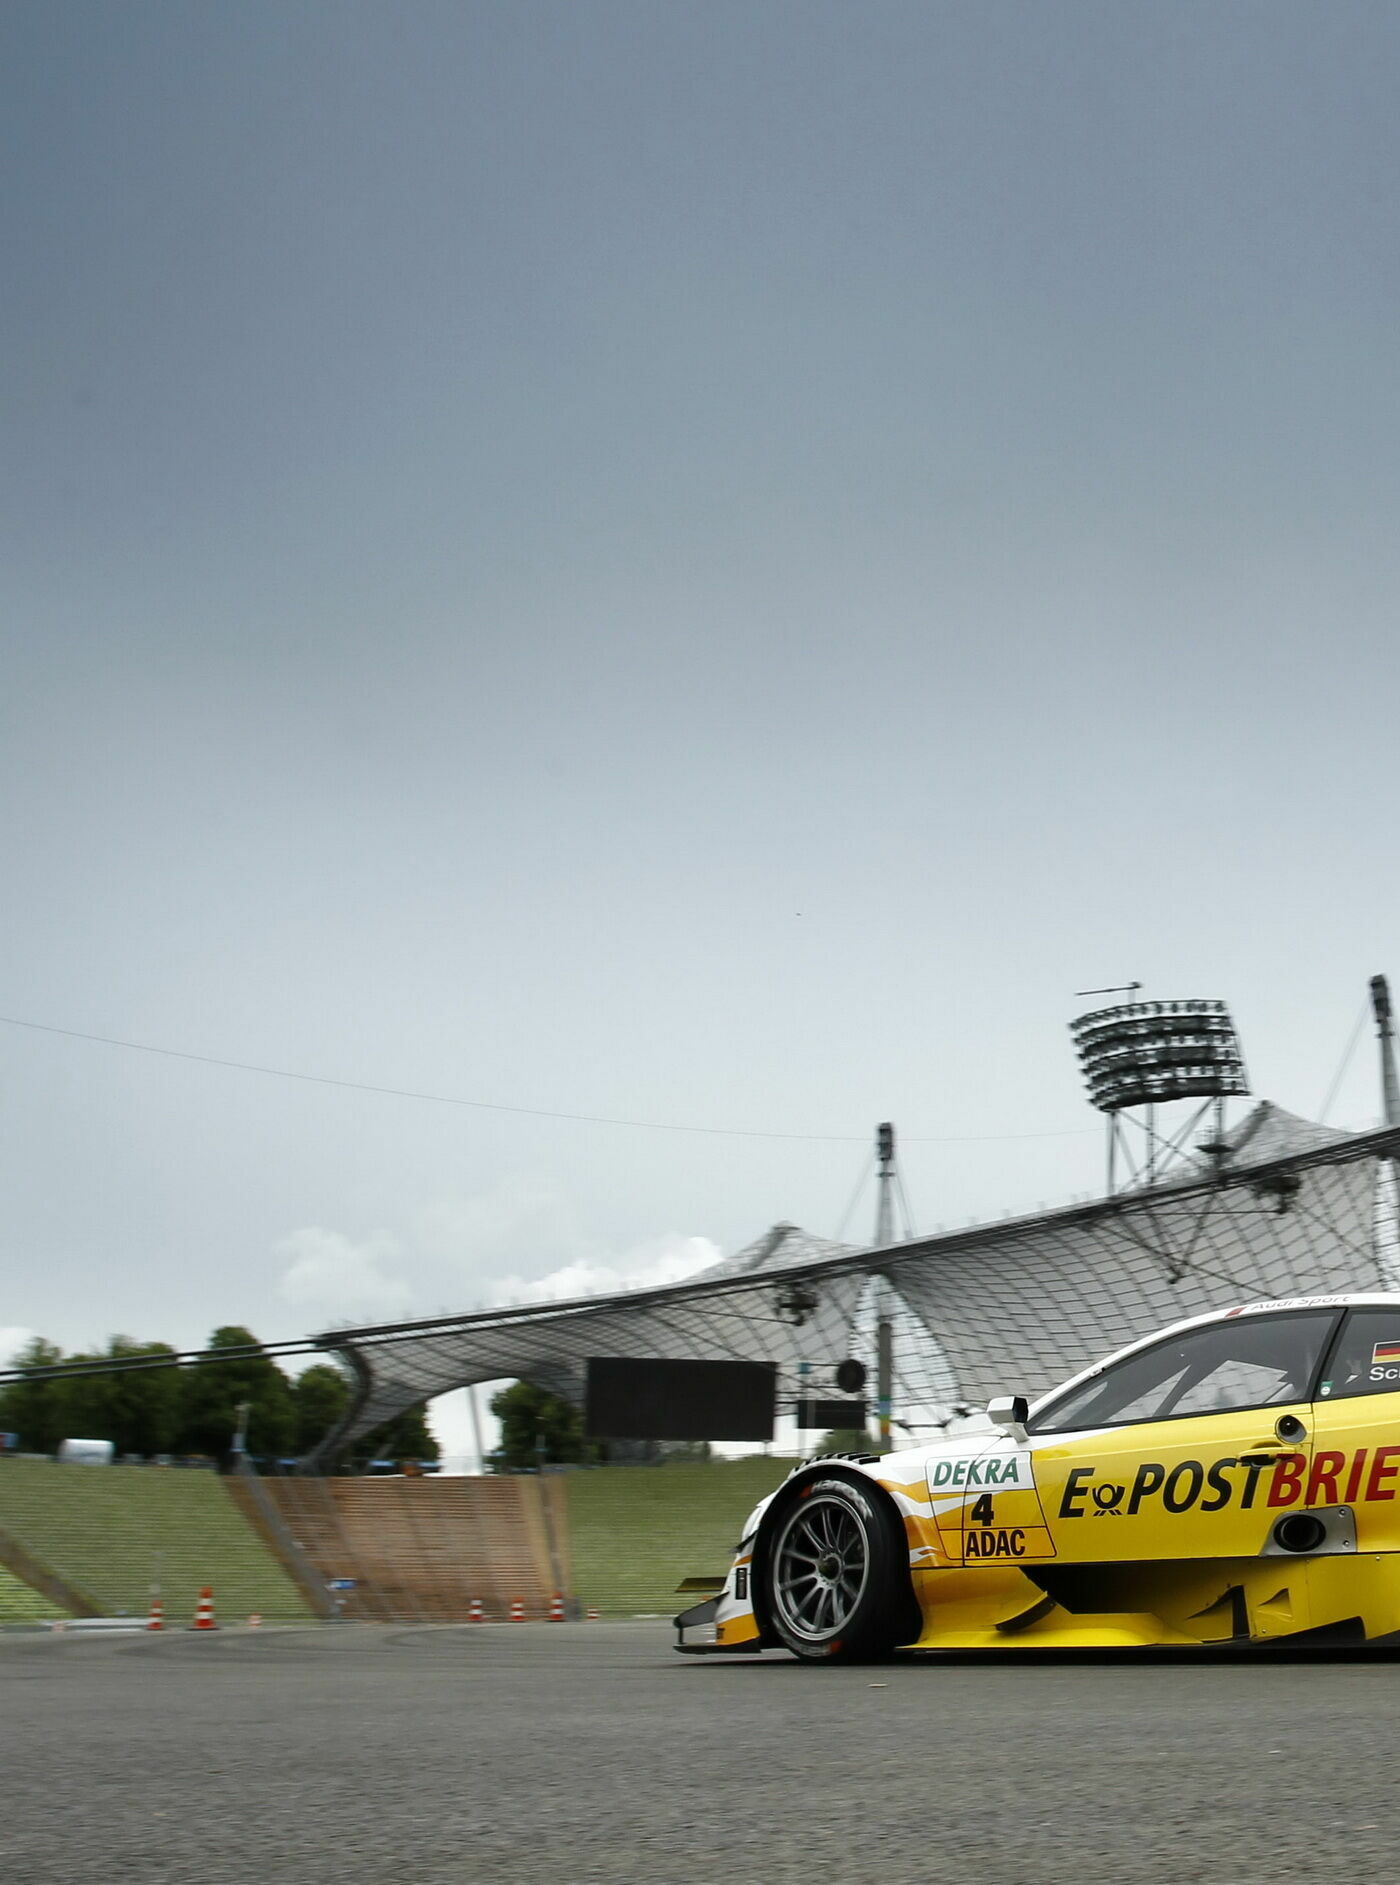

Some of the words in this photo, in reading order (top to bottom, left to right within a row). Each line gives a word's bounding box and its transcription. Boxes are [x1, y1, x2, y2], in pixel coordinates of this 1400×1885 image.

[1251, 1299, 1293, 1311] Audi
[1297, 1296, 1351, 1307] Sport
[933, 1457, 1019, 1486] DEKRA
[971, 1493, 994, 1527] 4
[965, 1530, 1025, 1558] ADAC
